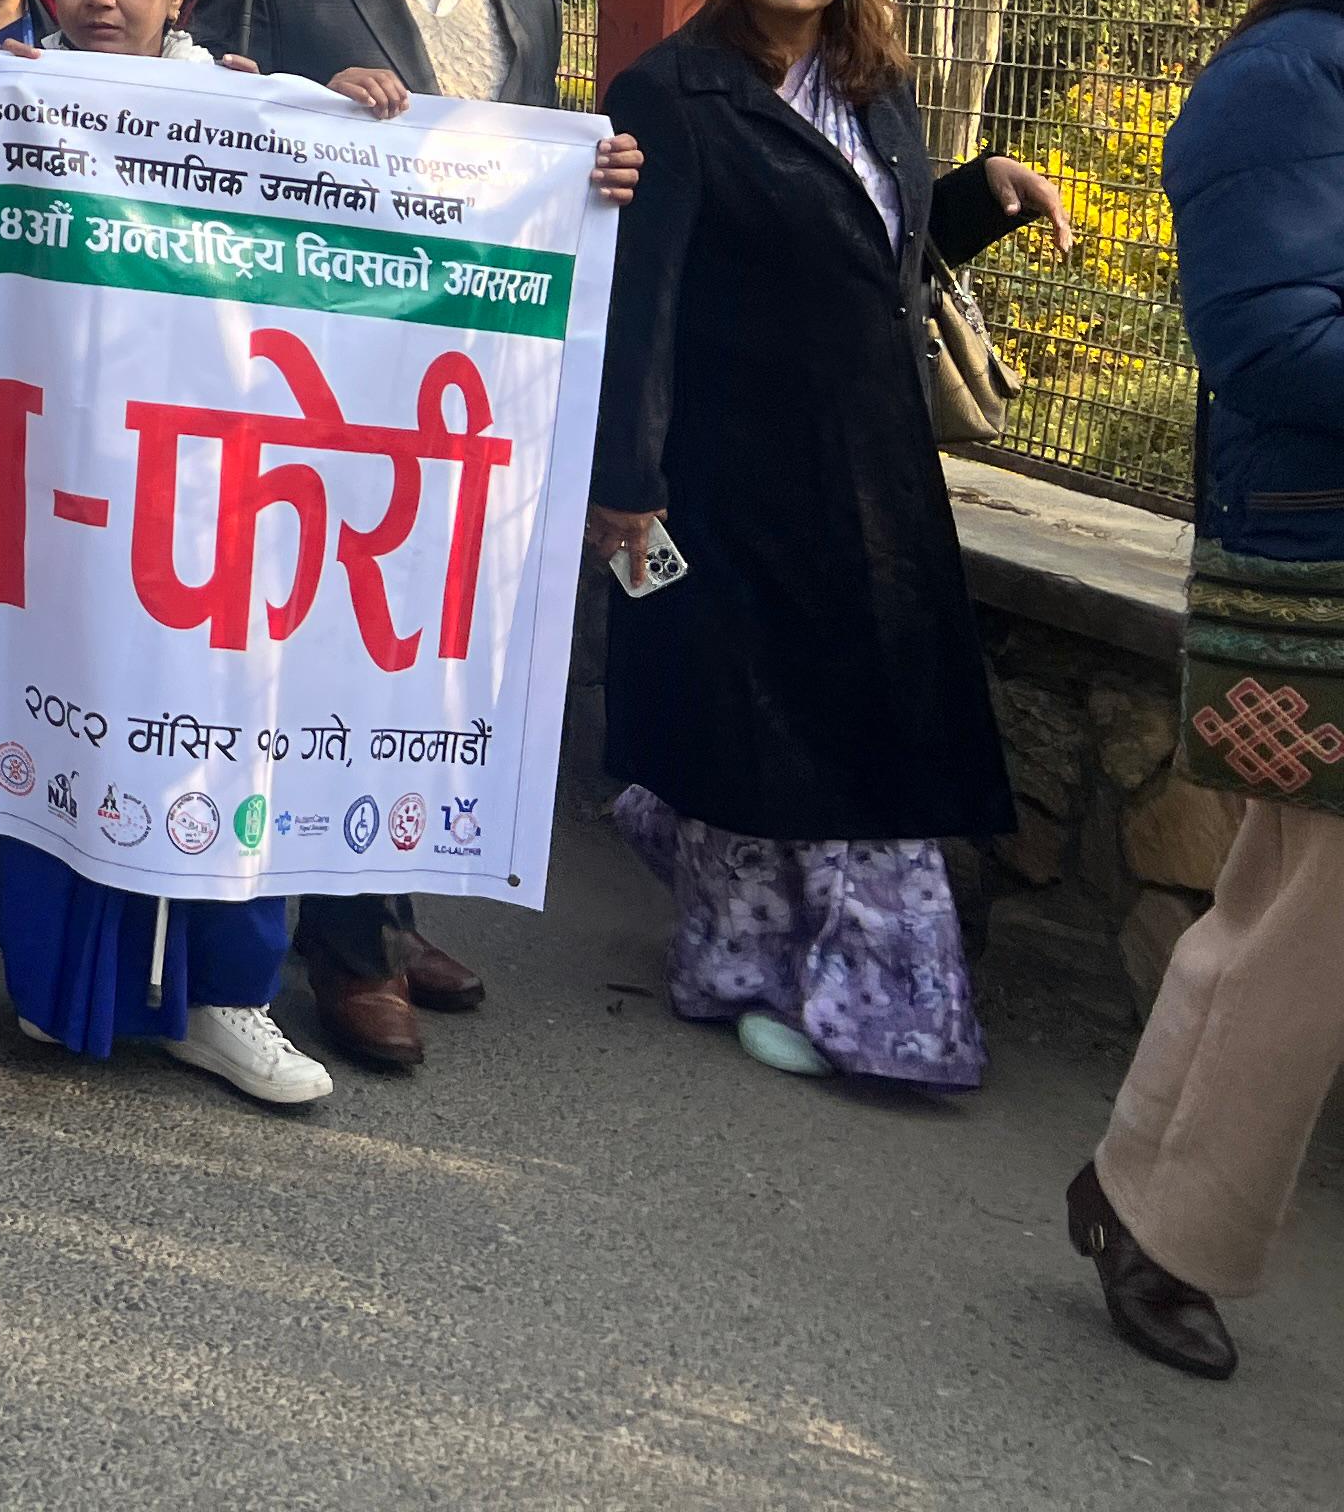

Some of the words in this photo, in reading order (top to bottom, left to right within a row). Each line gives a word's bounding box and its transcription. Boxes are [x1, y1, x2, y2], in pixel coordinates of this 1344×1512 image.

[115, 109, 160, 138] for
[167, 119, 308, 163] advancing
[313, 139, 380, 168] social
[113, 154, 252, 197] सामाजिक
[259, 173, 379, 215] उन्नतिको
[295, 231, 431, 292] दिवसको
[442, 259, 552, 306] अवसरमा
[25, 685, 108, 747] २०८२
[127, 711, 243, 763] मंसिर
[256, 728, 289, 763] १७
[47, 784, 78, 818] NAB
